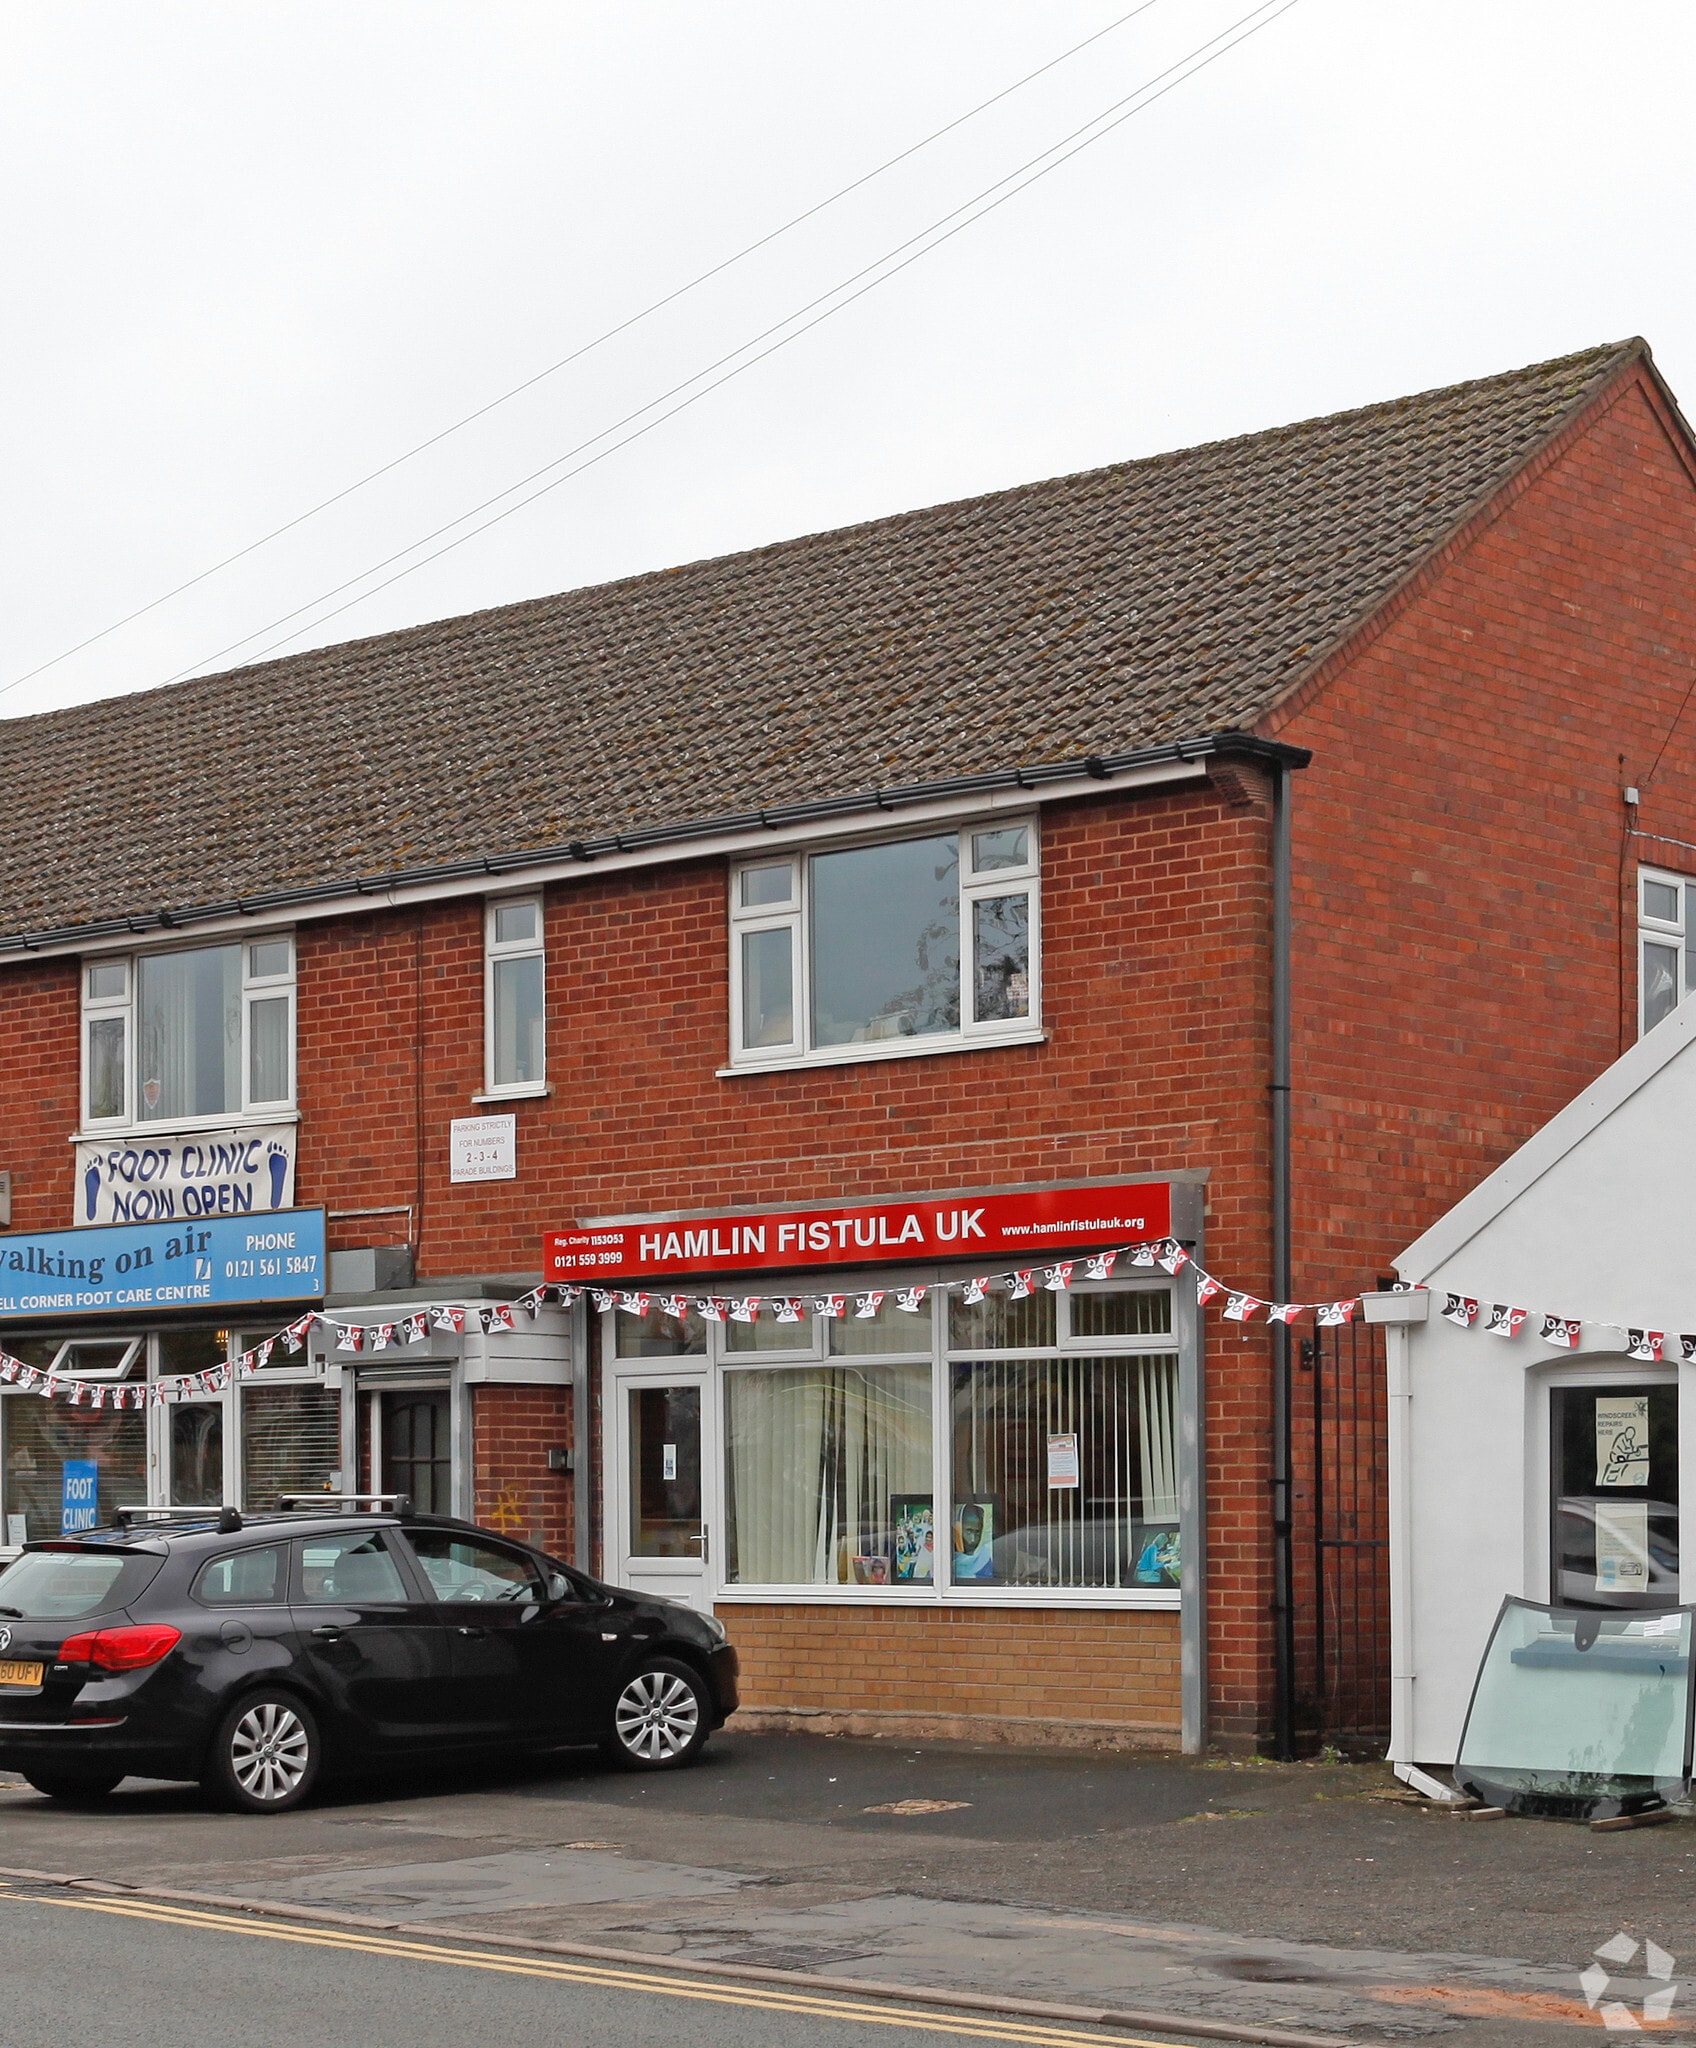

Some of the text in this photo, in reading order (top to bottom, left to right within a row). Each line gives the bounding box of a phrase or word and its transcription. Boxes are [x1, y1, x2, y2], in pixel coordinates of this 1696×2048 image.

[453, 1121, 512, 1133] PARKING STRICTLY
[460, 1137, 505, 1148] FOR NUMBERS
[107, 1139, 262, 1183] FOOT CLINIC
[453, 1164, 513, 1176] PARADE BUILDINGS
[112, 1182, 252, 1222] NOW OPEN
[639, 1208, 986, 1262] HAMLIN FISTULA UK
[1001, 1217, 1145, 1236] www.hamlinfistulauk.org
[115, 1246, 154, 1274] on
[165, 1226, 212, 1260] air
[246, 1232, 296, 1251] PHONE
[591, 1234, 624, 1246] 1153053
[225, 1255, 317, 1278] 0121 561 5847
[554, 1251, 623, 1268] 0121 559 3999
[313, 1278, 319, 1292] 3
[20, 1293, 73, 1309] CORNER
[76, 1291, 113, 1306] FOOT
[116, 1288, 152, 1303] CARE
[156, 1284, 210, 1301] CENTRE
[66, 1478, 93, 1500] FOOT
[63, 1507, 95, 1530] CLINIC
